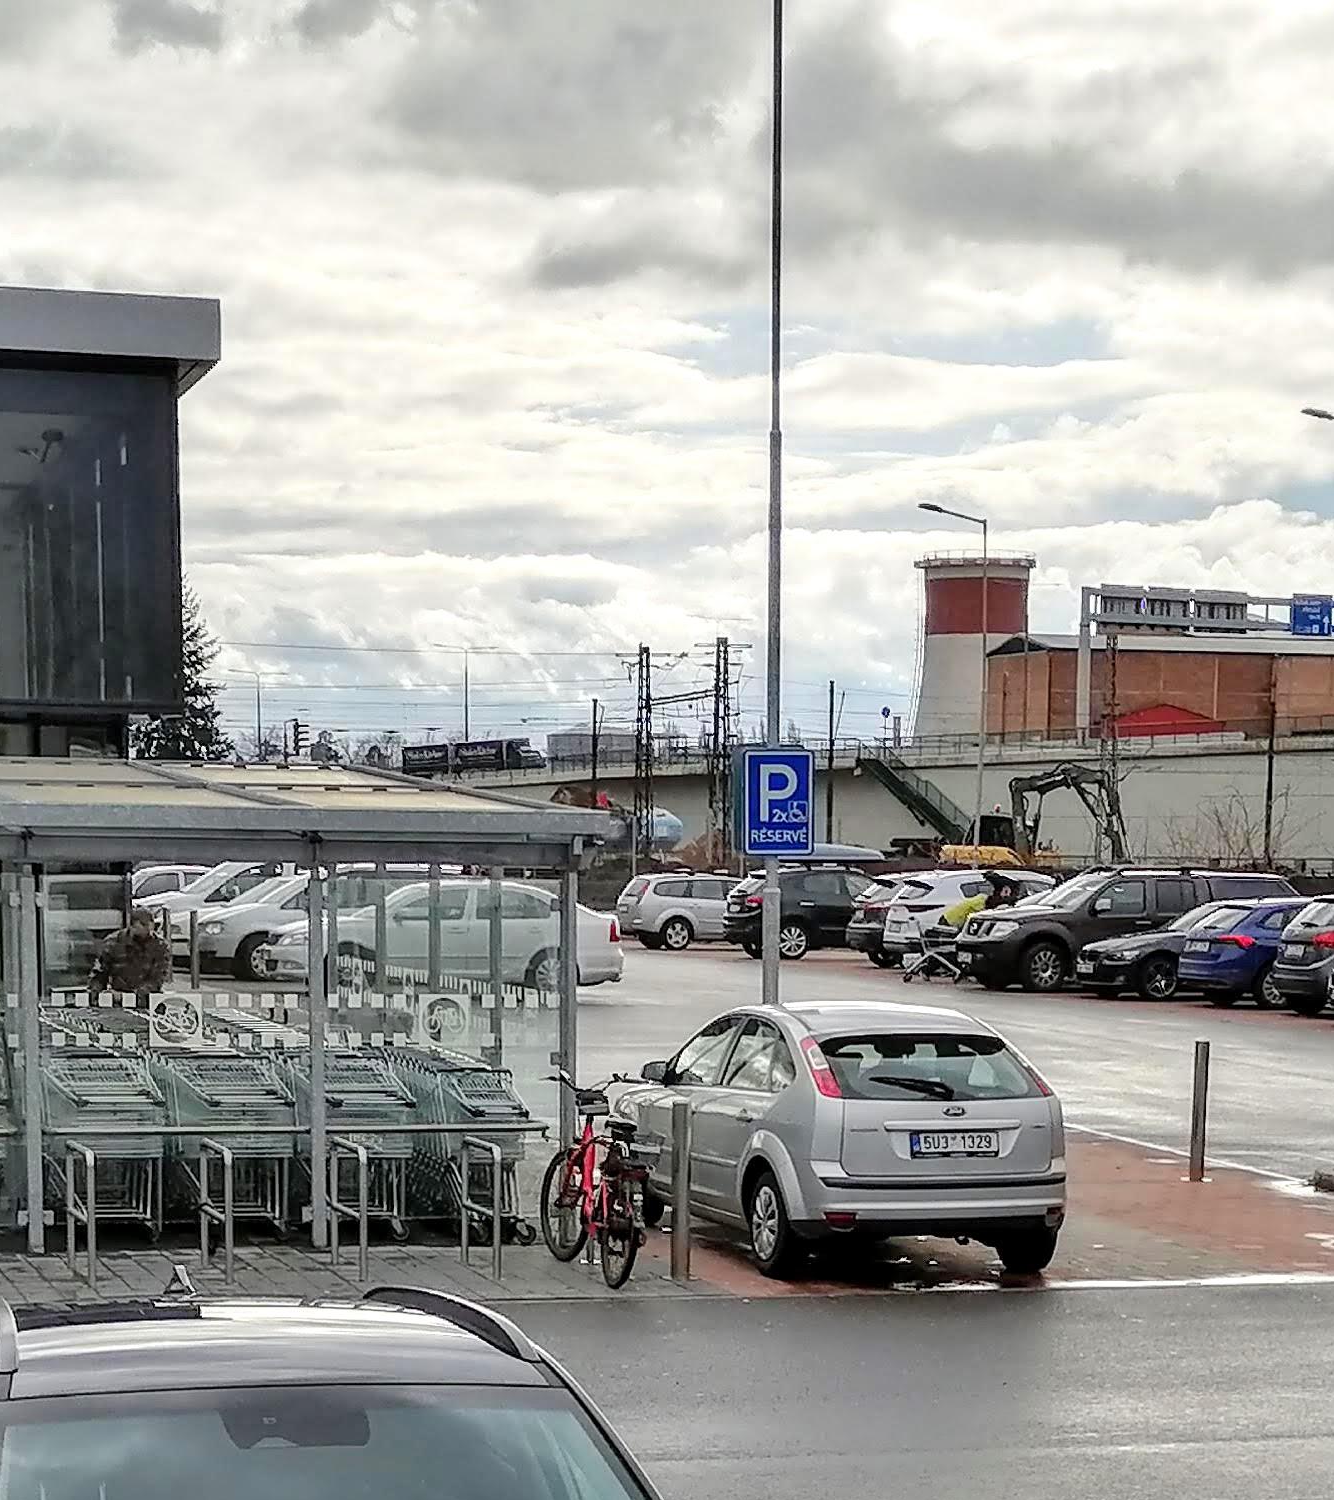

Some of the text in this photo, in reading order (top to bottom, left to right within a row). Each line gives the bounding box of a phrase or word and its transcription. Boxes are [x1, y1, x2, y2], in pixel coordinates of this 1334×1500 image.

[759, 764, 798, 822] P
[772, 809, 789, 823] 2x
[750, 827, 808, 843] RÉSERVÉ
[923, 1135, 993, 1149] 5U3 1329
